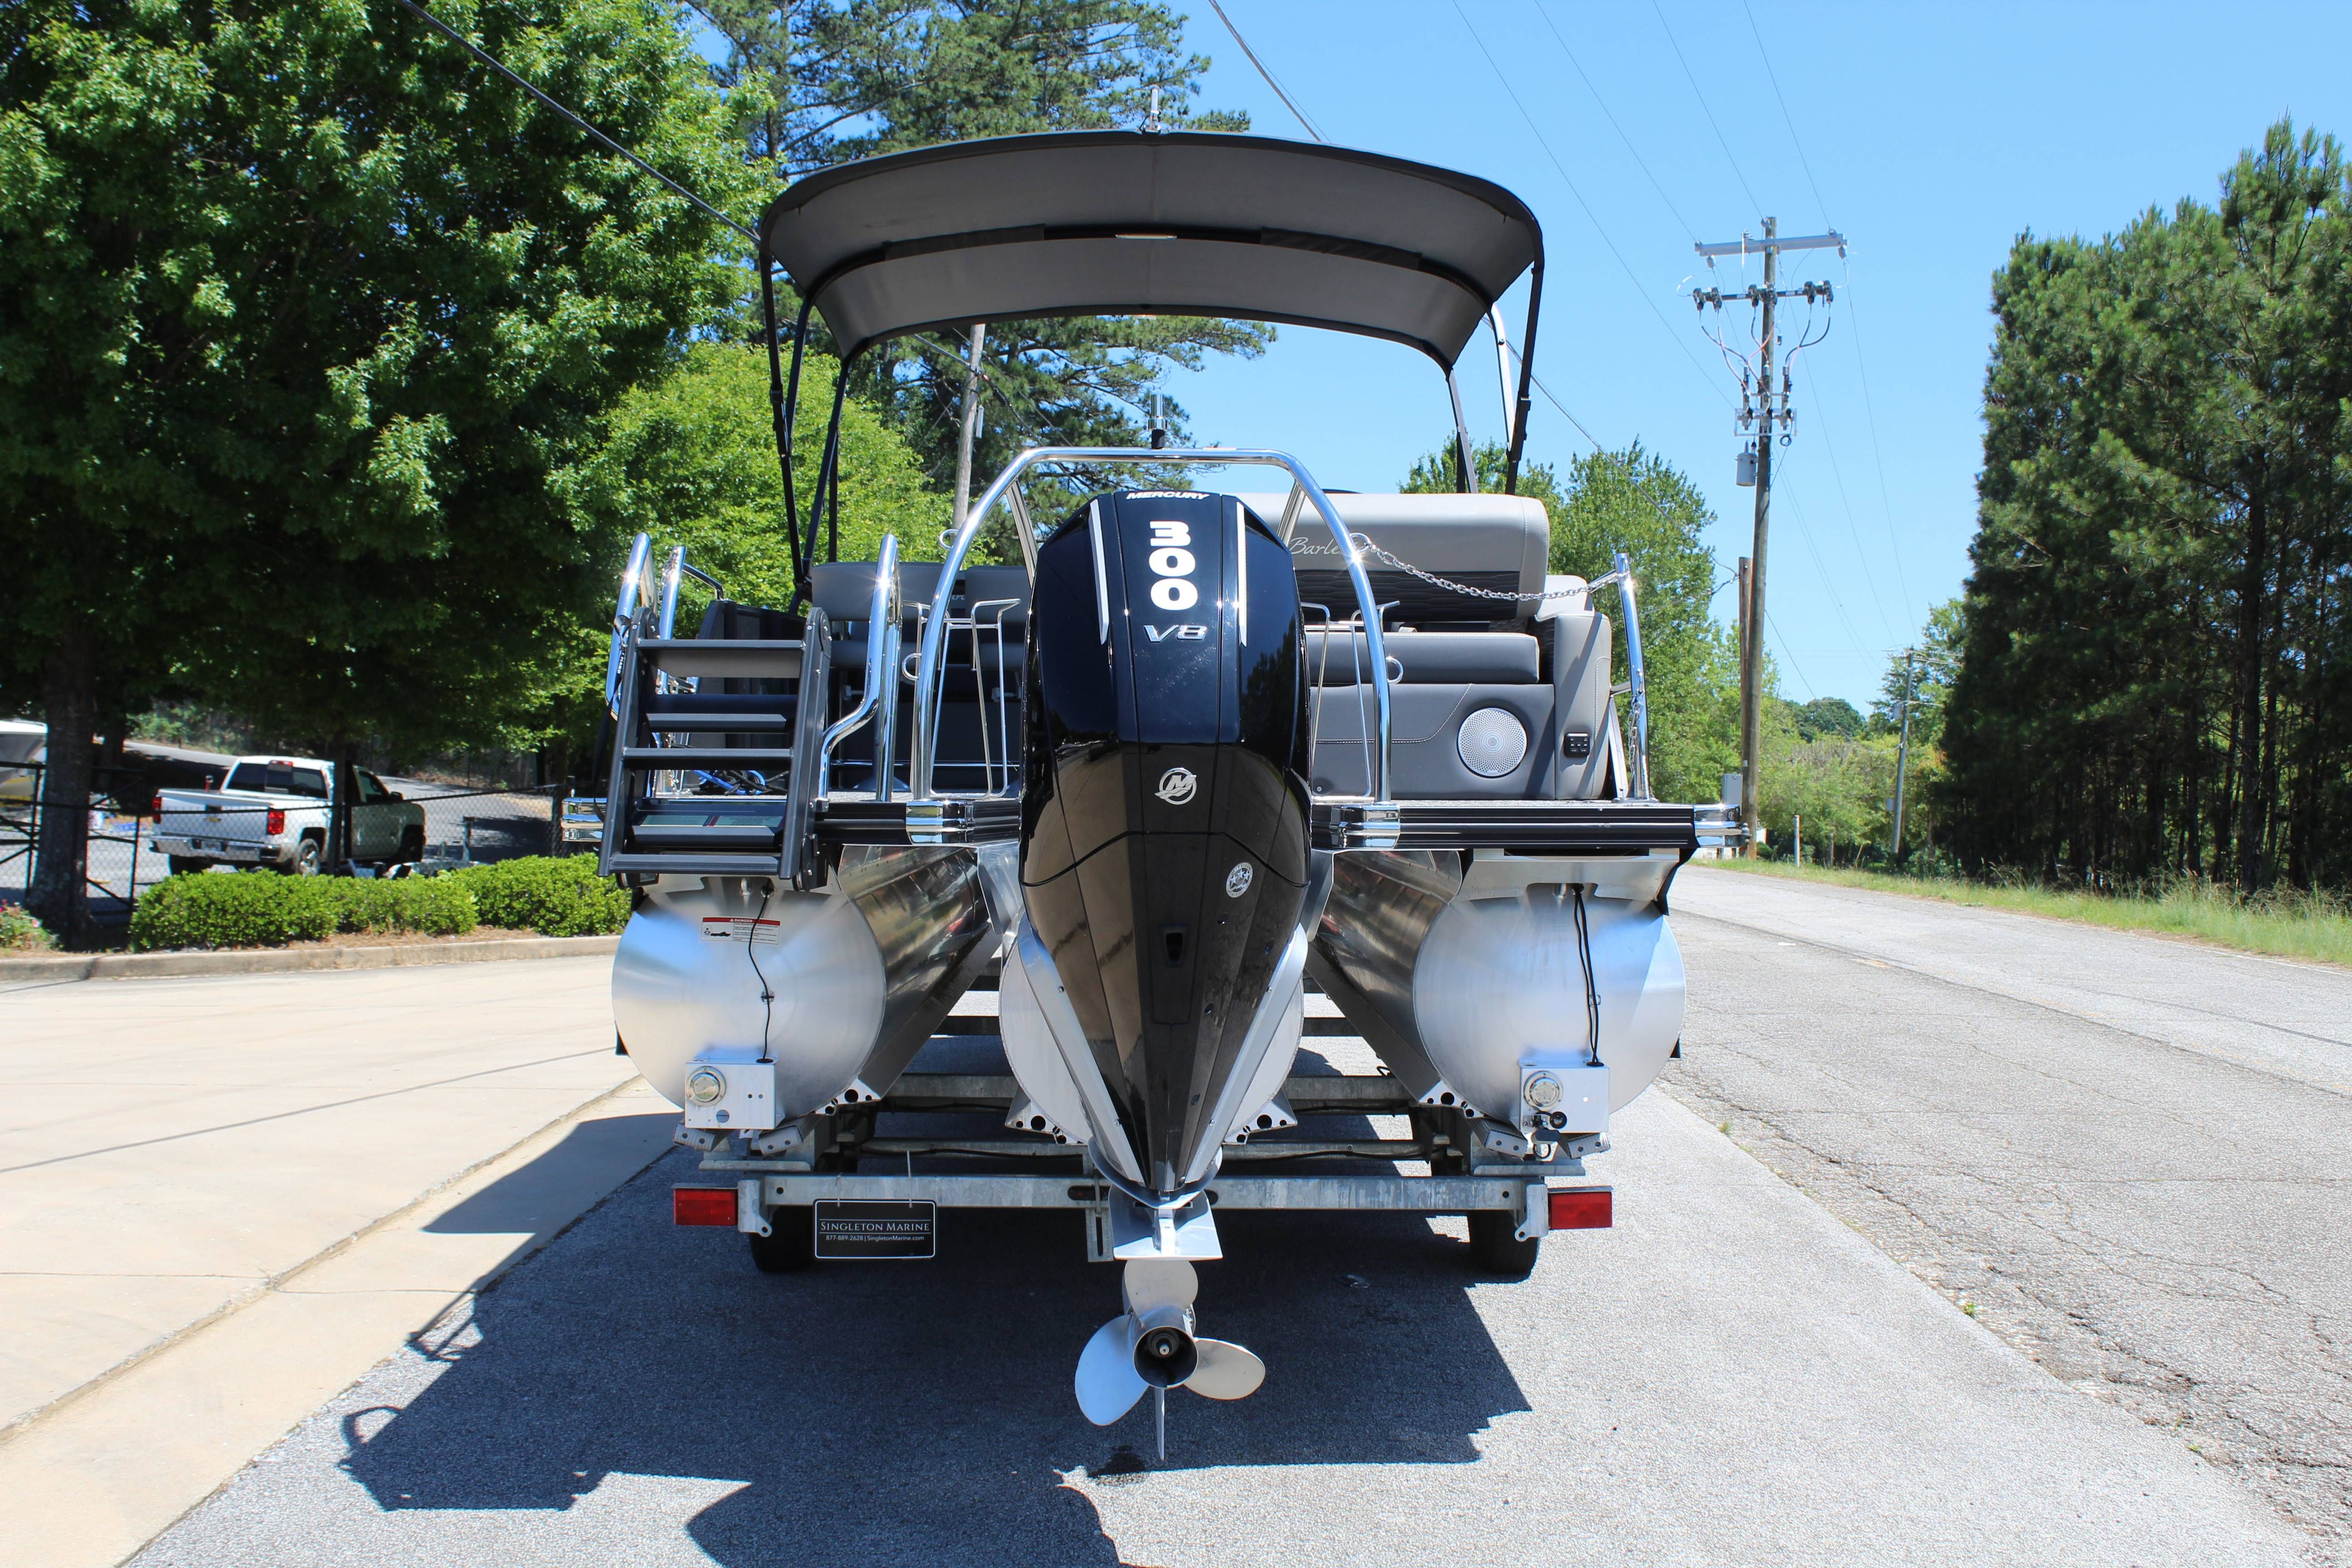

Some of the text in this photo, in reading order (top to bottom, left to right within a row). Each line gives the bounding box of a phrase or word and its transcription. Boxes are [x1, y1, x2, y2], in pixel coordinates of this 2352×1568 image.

[1126, 491, 1210, 500] MERCURY
[1289, 537, 1350, 555] Barle
[1149, 521, 1198, 610] 300
[1143, 624, 1207, 643] V8
[821, 1221, 930, 1231] SINGLETON MARINE
